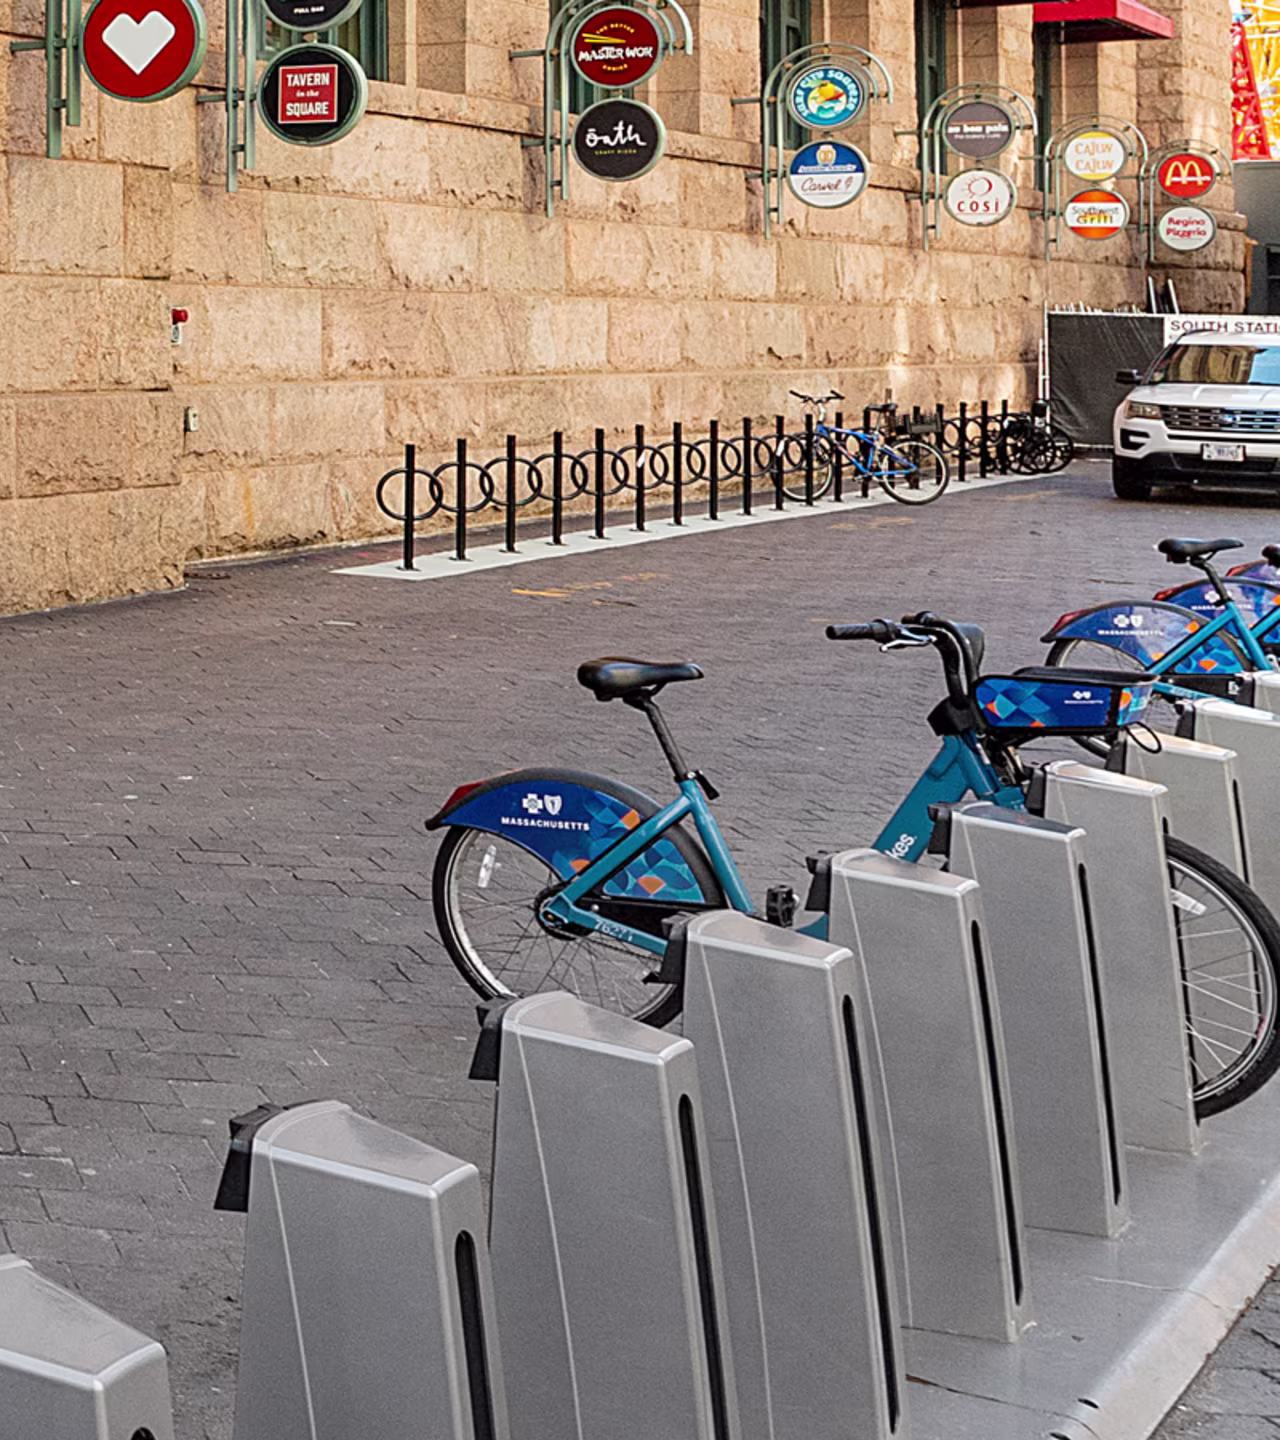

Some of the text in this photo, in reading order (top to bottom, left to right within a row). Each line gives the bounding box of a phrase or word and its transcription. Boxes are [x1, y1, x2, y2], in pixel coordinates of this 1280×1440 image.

[578, 46, 653, 61] MASTER WOK
[286, 72, 330, 87] TAVERN
[286, 102, 329, 117] SQUARE
[1234, 322, 1280, 334] STATI
[501, 816, 590, 832] MASSACHUSETTS
